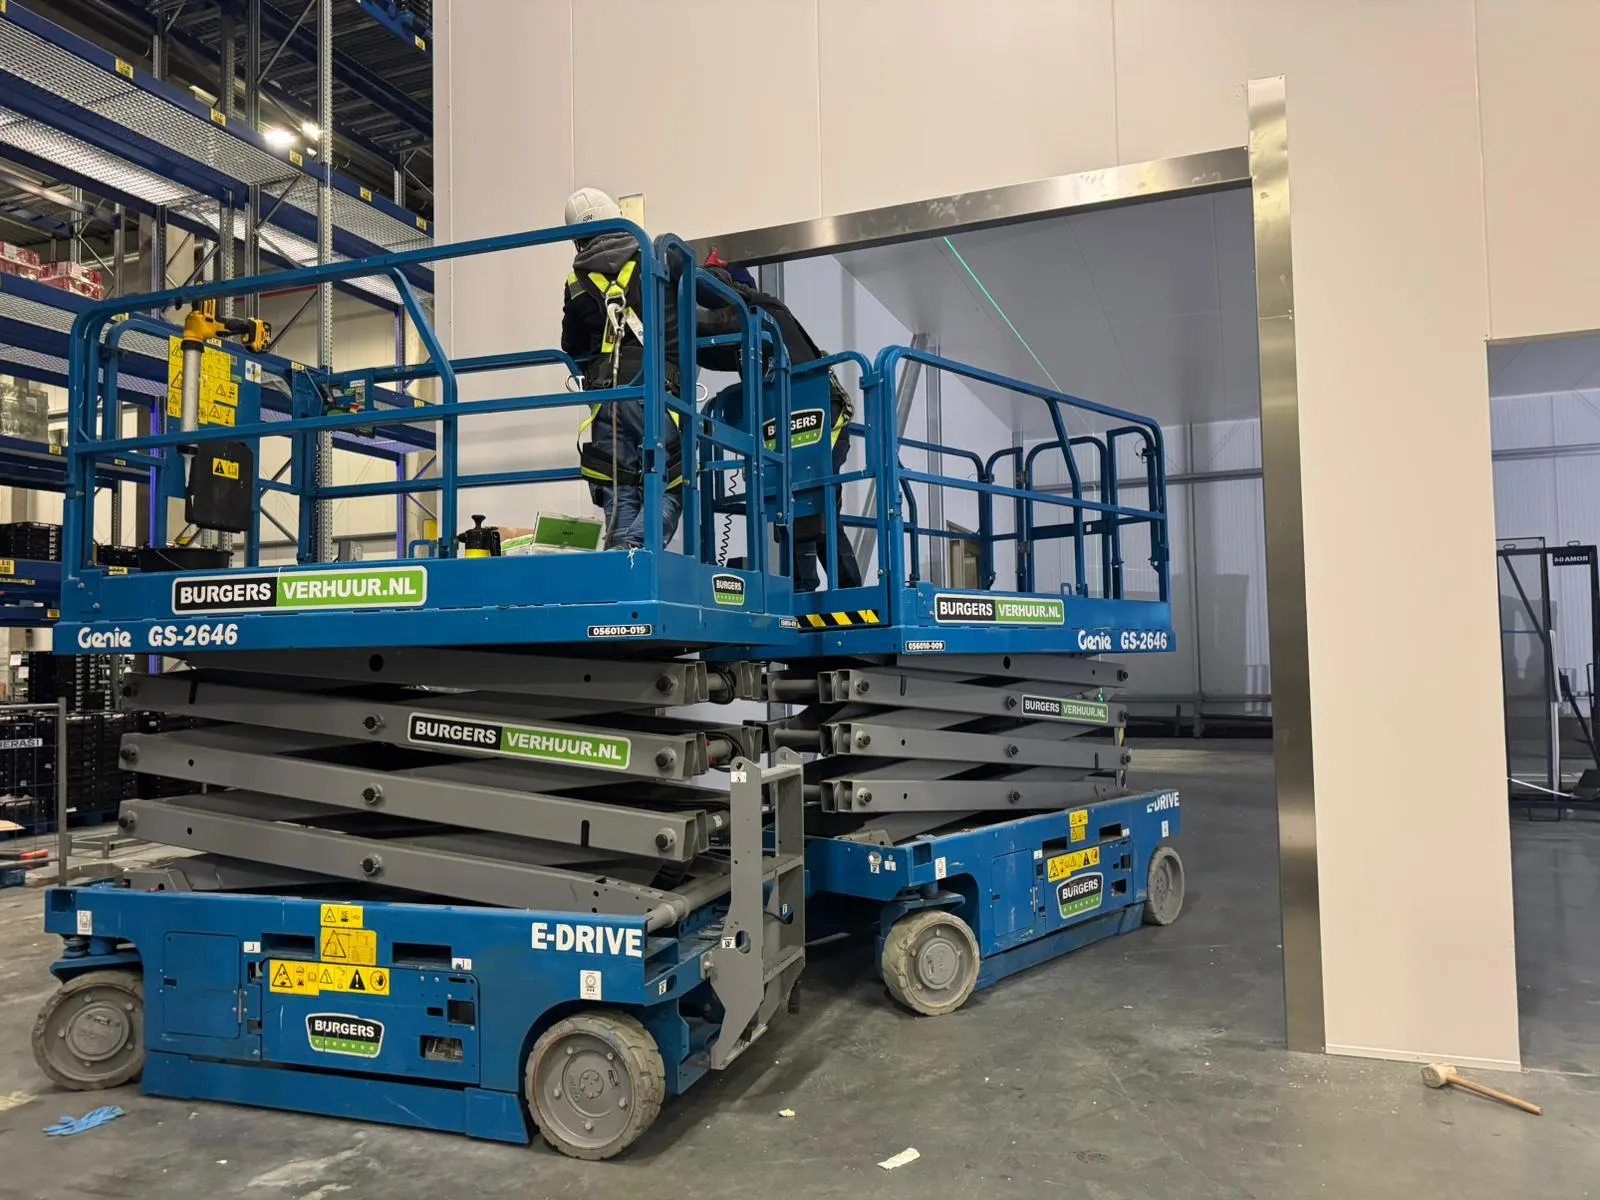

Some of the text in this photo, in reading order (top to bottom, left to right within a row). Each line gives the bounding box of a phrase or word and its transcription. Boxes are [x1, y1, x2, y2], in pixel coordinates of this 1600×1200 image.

[767, 415, 817, 436] BGERS
[180, 577, 416, 604] BURGERS VERHUUR.NL
[716, 579, 742, 591] BURGERS
[939, 600, 1061, 619] BURGERS VERHUUR.NL
[78, 624, 239, 649] Genie GS-2646
[1077, 630, 1168, 650] Genie GS-2646
[1024, 699, 1106, 719] BURGERS VERHUUR.NL
[414, 720, 621, 761] BURGERS VERHUUR.NL
[1062, 878, 1099, 900] BURGERS
[531, 922, 643, 957] E-DRIVE
[314, 1019, 375, 1038] BURGERS
